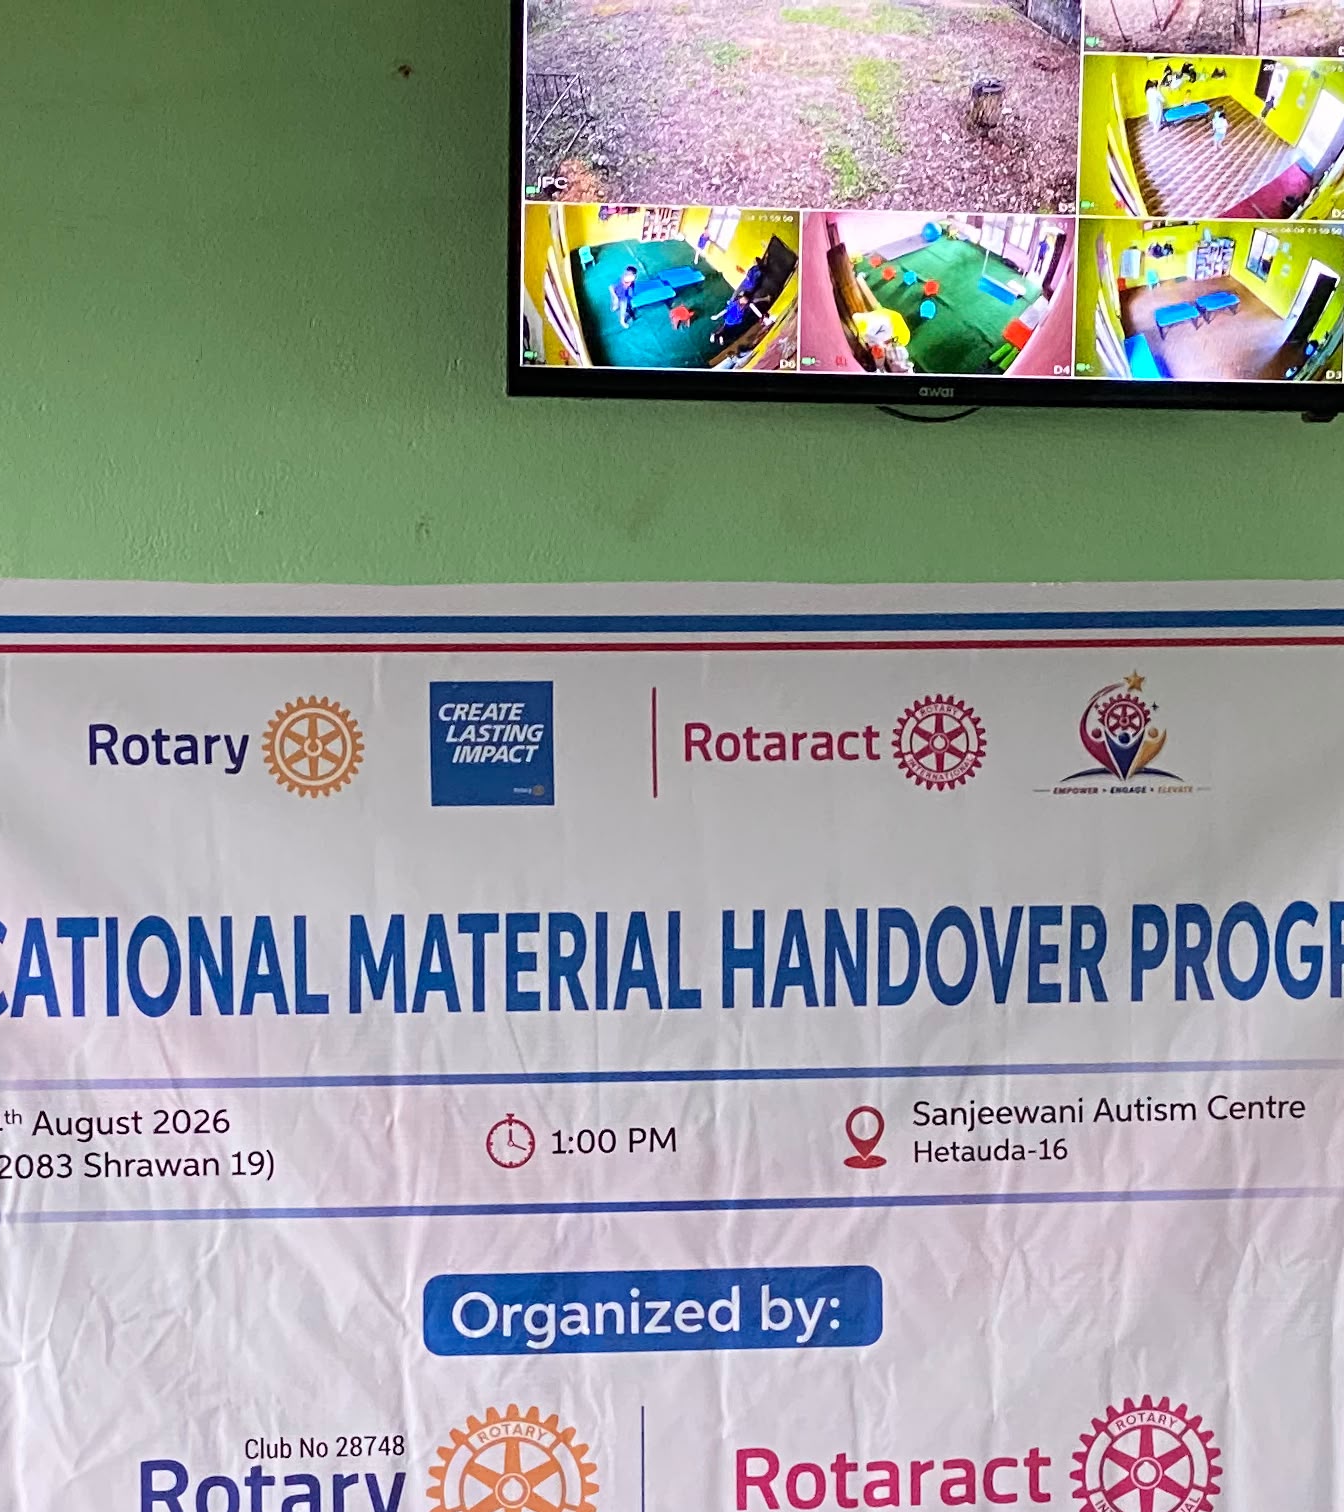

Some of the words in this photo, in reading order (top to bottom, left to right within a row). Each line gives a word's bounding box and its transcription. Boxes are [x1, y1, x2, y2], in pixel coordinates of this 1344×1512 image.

[438, 703, 526, 721] CREATE
[920, 704, 958, 716] ROTARY
[445, 724, 545, 742] LASTING
[684, 722, 881, 762] Rotaract
[88, 722, 250, 775] Rotary
[452, 745, 539, 763] IMPACT
[908, 755, 973, 780] INTERNATIONAL
[1053, 787, 1098, 795] EMPOWER
[1110, 786, 1147, 794] ENGAGE
[349, 909, 701, 1014] MATERIAL
[721, 904, 1109, 1010] HANDOVER
[911, 1097, 1084, 1129] Sanjeewani
[1093, 1094, 1199, 1125] Autism
[1205, 1093, 1307, 1122] Centre
[31, 1110, 145, 1143] August
[153, 1108, 231, 1136] 2026
[550, 1129, 618, 1156] 1:00
[628, 1127, 678, 1154] PM
[913, 1138, 1069, 1165] Hetauda-16
[83, 1151, 222, 1180] Shrawan
[230, 1148, 277, 1182] 19)
[451, 1285, 740, 1350] Organized
[761, 1284, 841, 1343] by:
[477, 1423, 550, 1444] ROTARY
[1116, 1412, 1178, 1431] ROTARY
[244, 1437, 292, 1460] Club
[300, 1437, 329, 1459] No
[336, 1435, 406, 1459] 28748
[735, 1447, 1052, 1512] Rotaract
